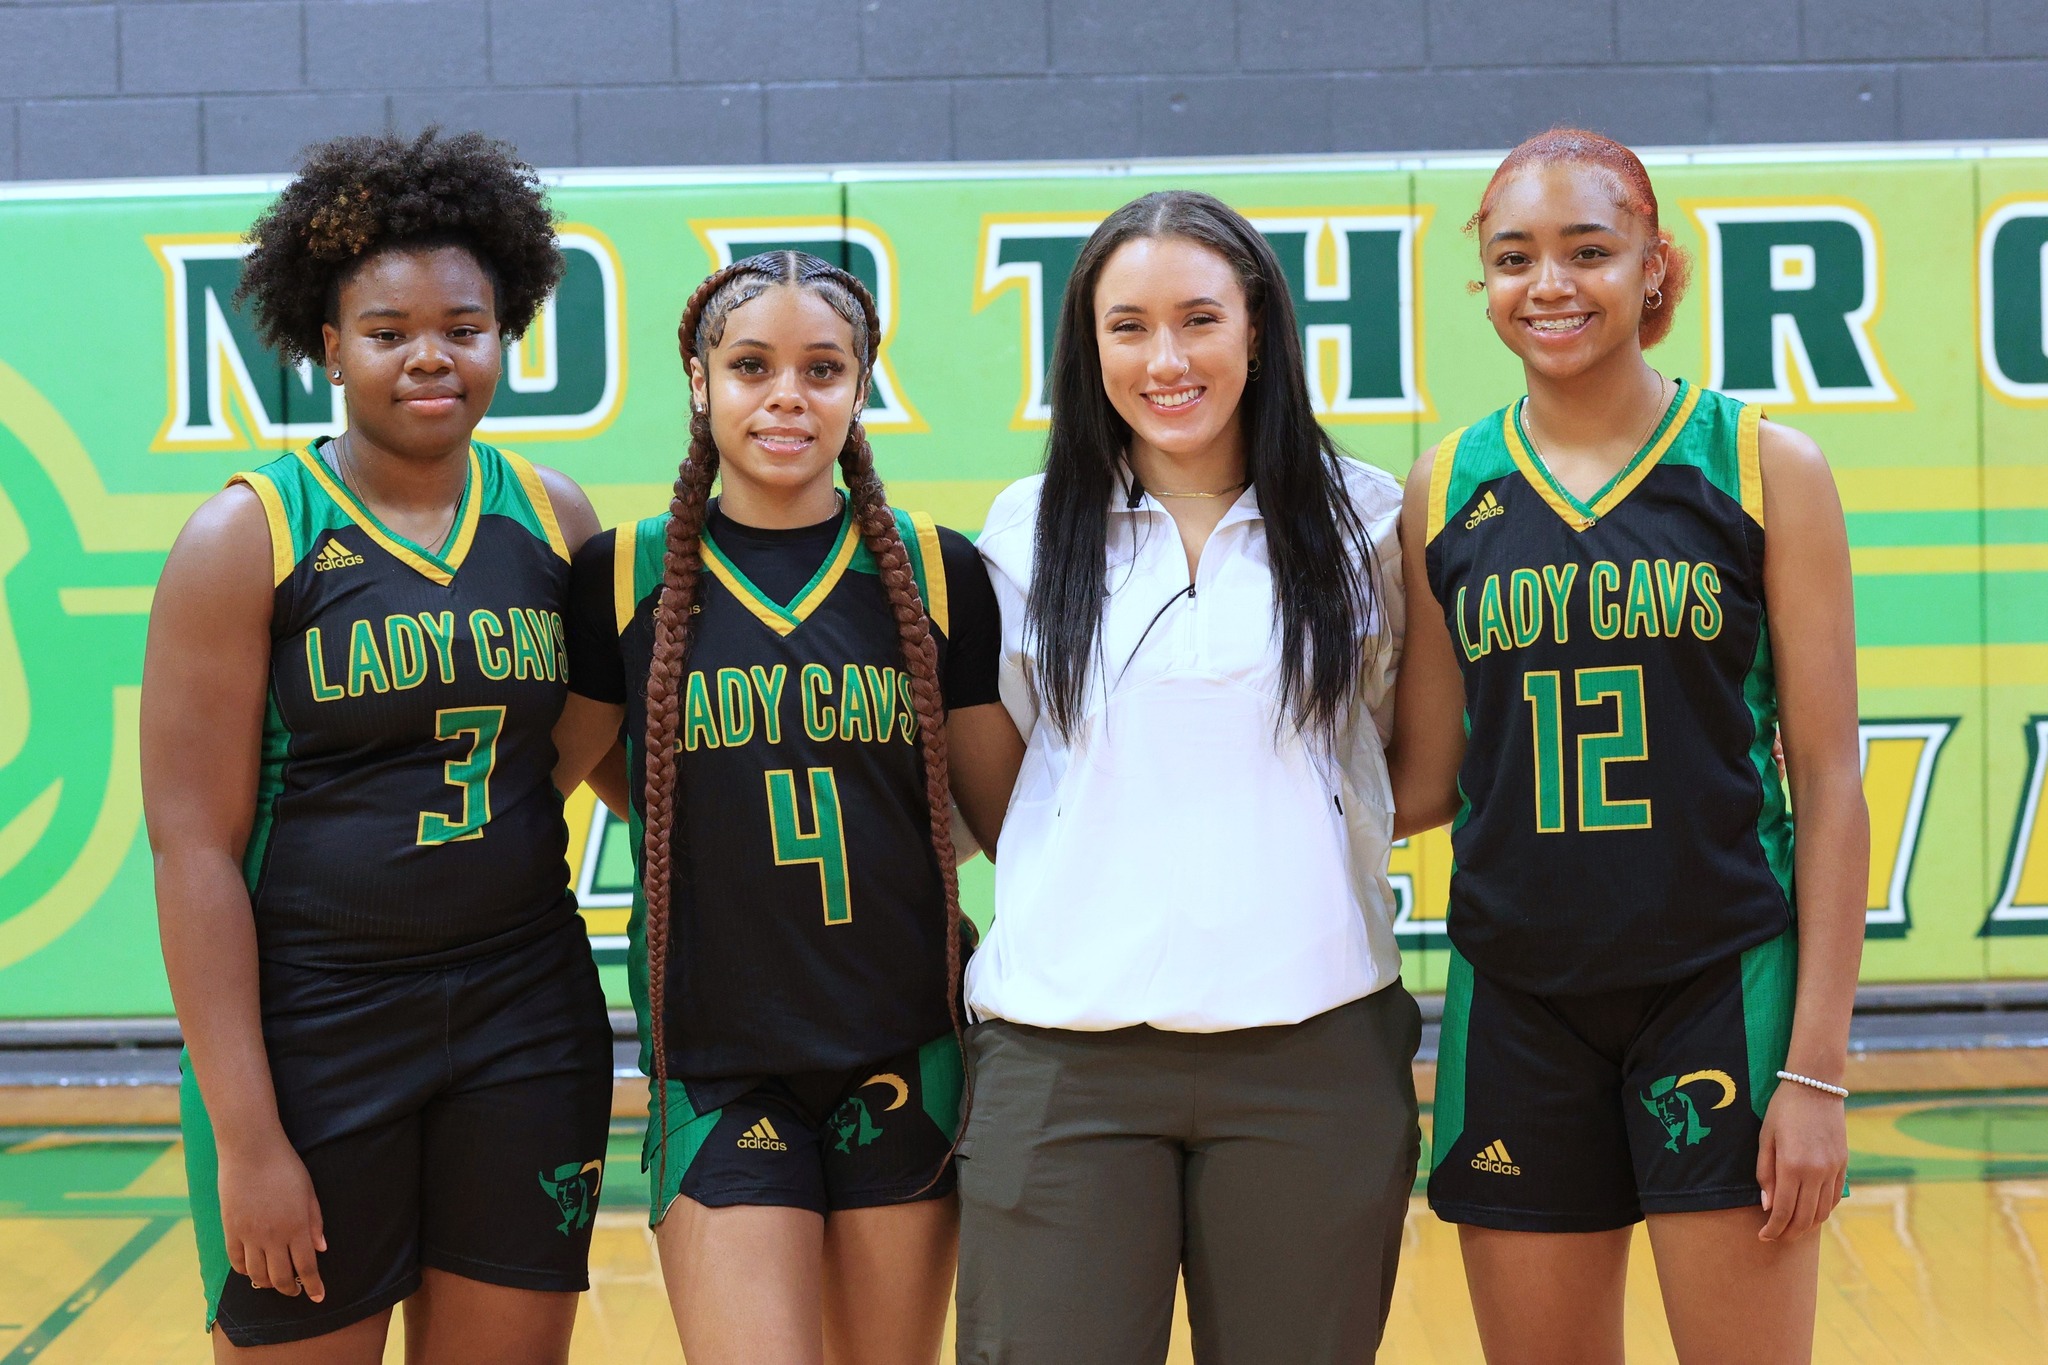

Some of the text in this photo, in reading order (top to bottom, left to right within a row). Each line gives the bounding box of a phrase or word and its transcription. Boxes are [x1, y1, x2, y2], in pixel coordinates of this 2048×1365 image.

[314, 554, 365, 572] adidas
[1465, 505, 1504, 529] addas
[305, 607, 569, 702] LADY CAVS
[1457, 558, 1723, 662] LADY CAVS
[673, 663, 920, 754] ADY CAVS
[1523, 665, 1652, 833] 12
[415, 705, 507, 846] 3
[764, 766, 852, 926] 4
[737, 1136, 788, 1151] adidas
[1470, 1158, 1521, 1176] adidas
